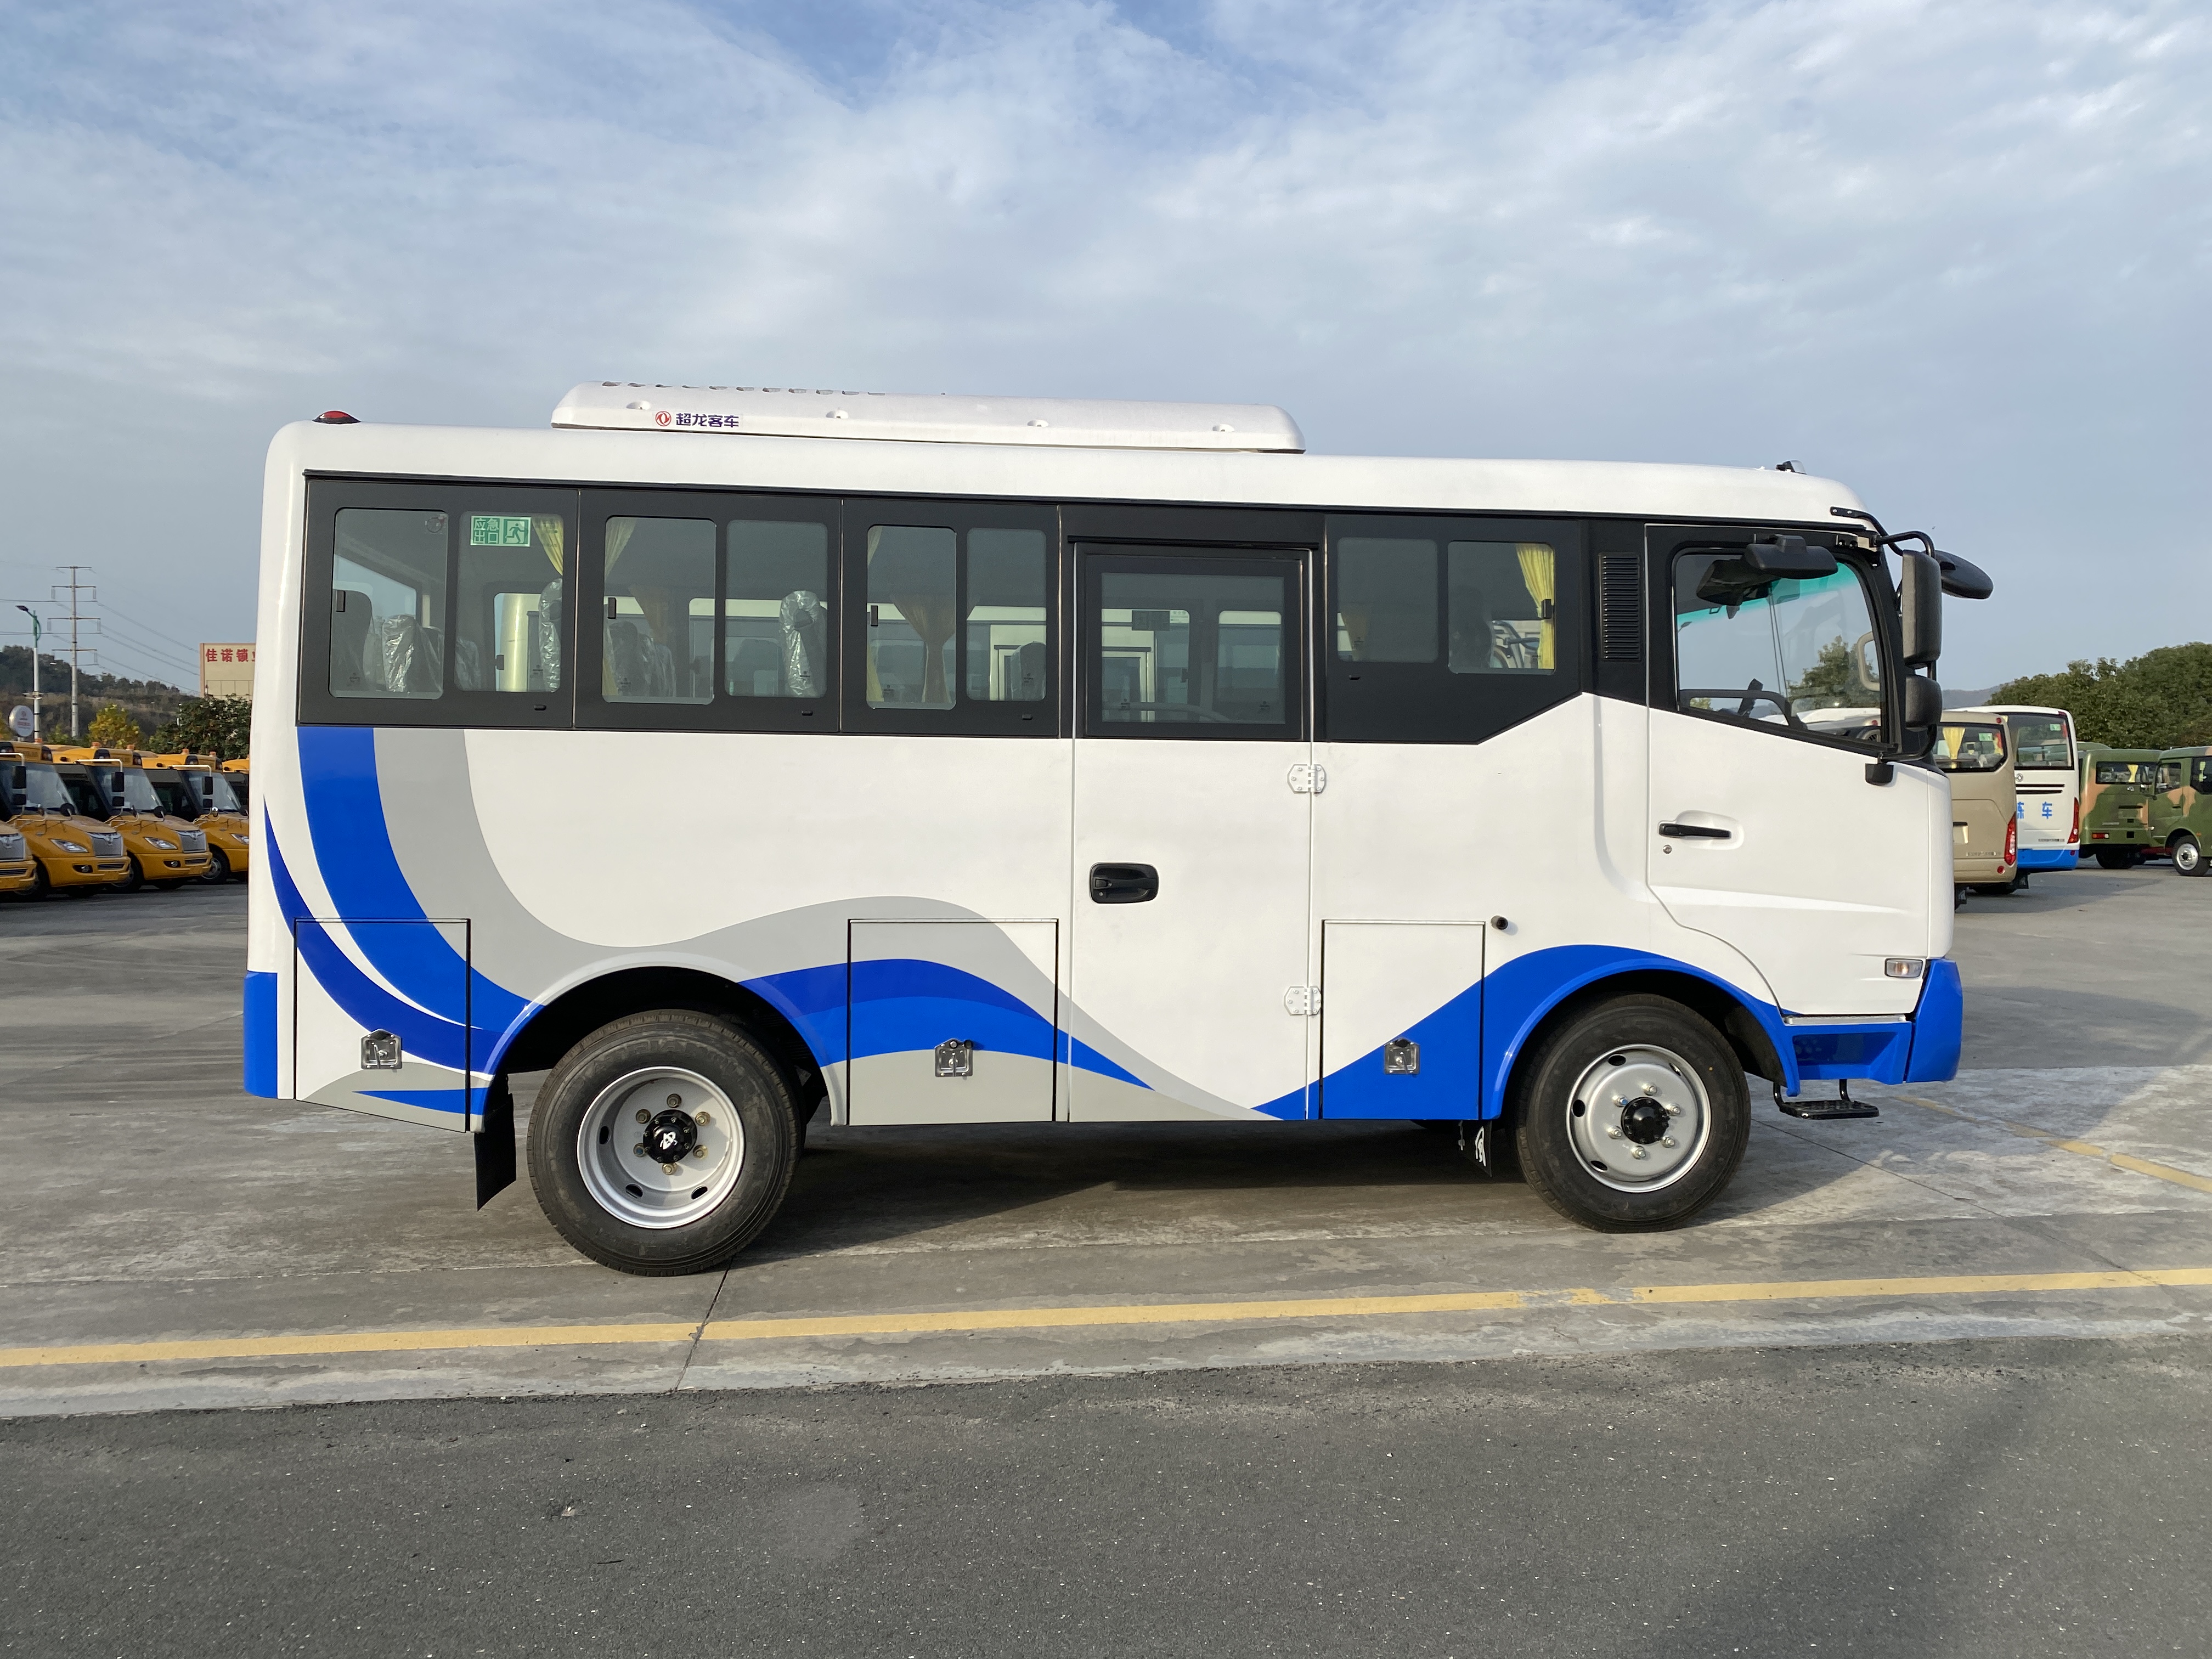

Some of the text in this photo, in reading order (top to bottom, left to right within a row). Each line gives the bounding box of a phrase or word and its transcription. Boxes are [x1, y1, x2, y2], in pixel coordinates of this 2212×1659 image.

[676, 413, 739, 427] 超龙客车
[206, 648, 255, 662] 佳诺锁
